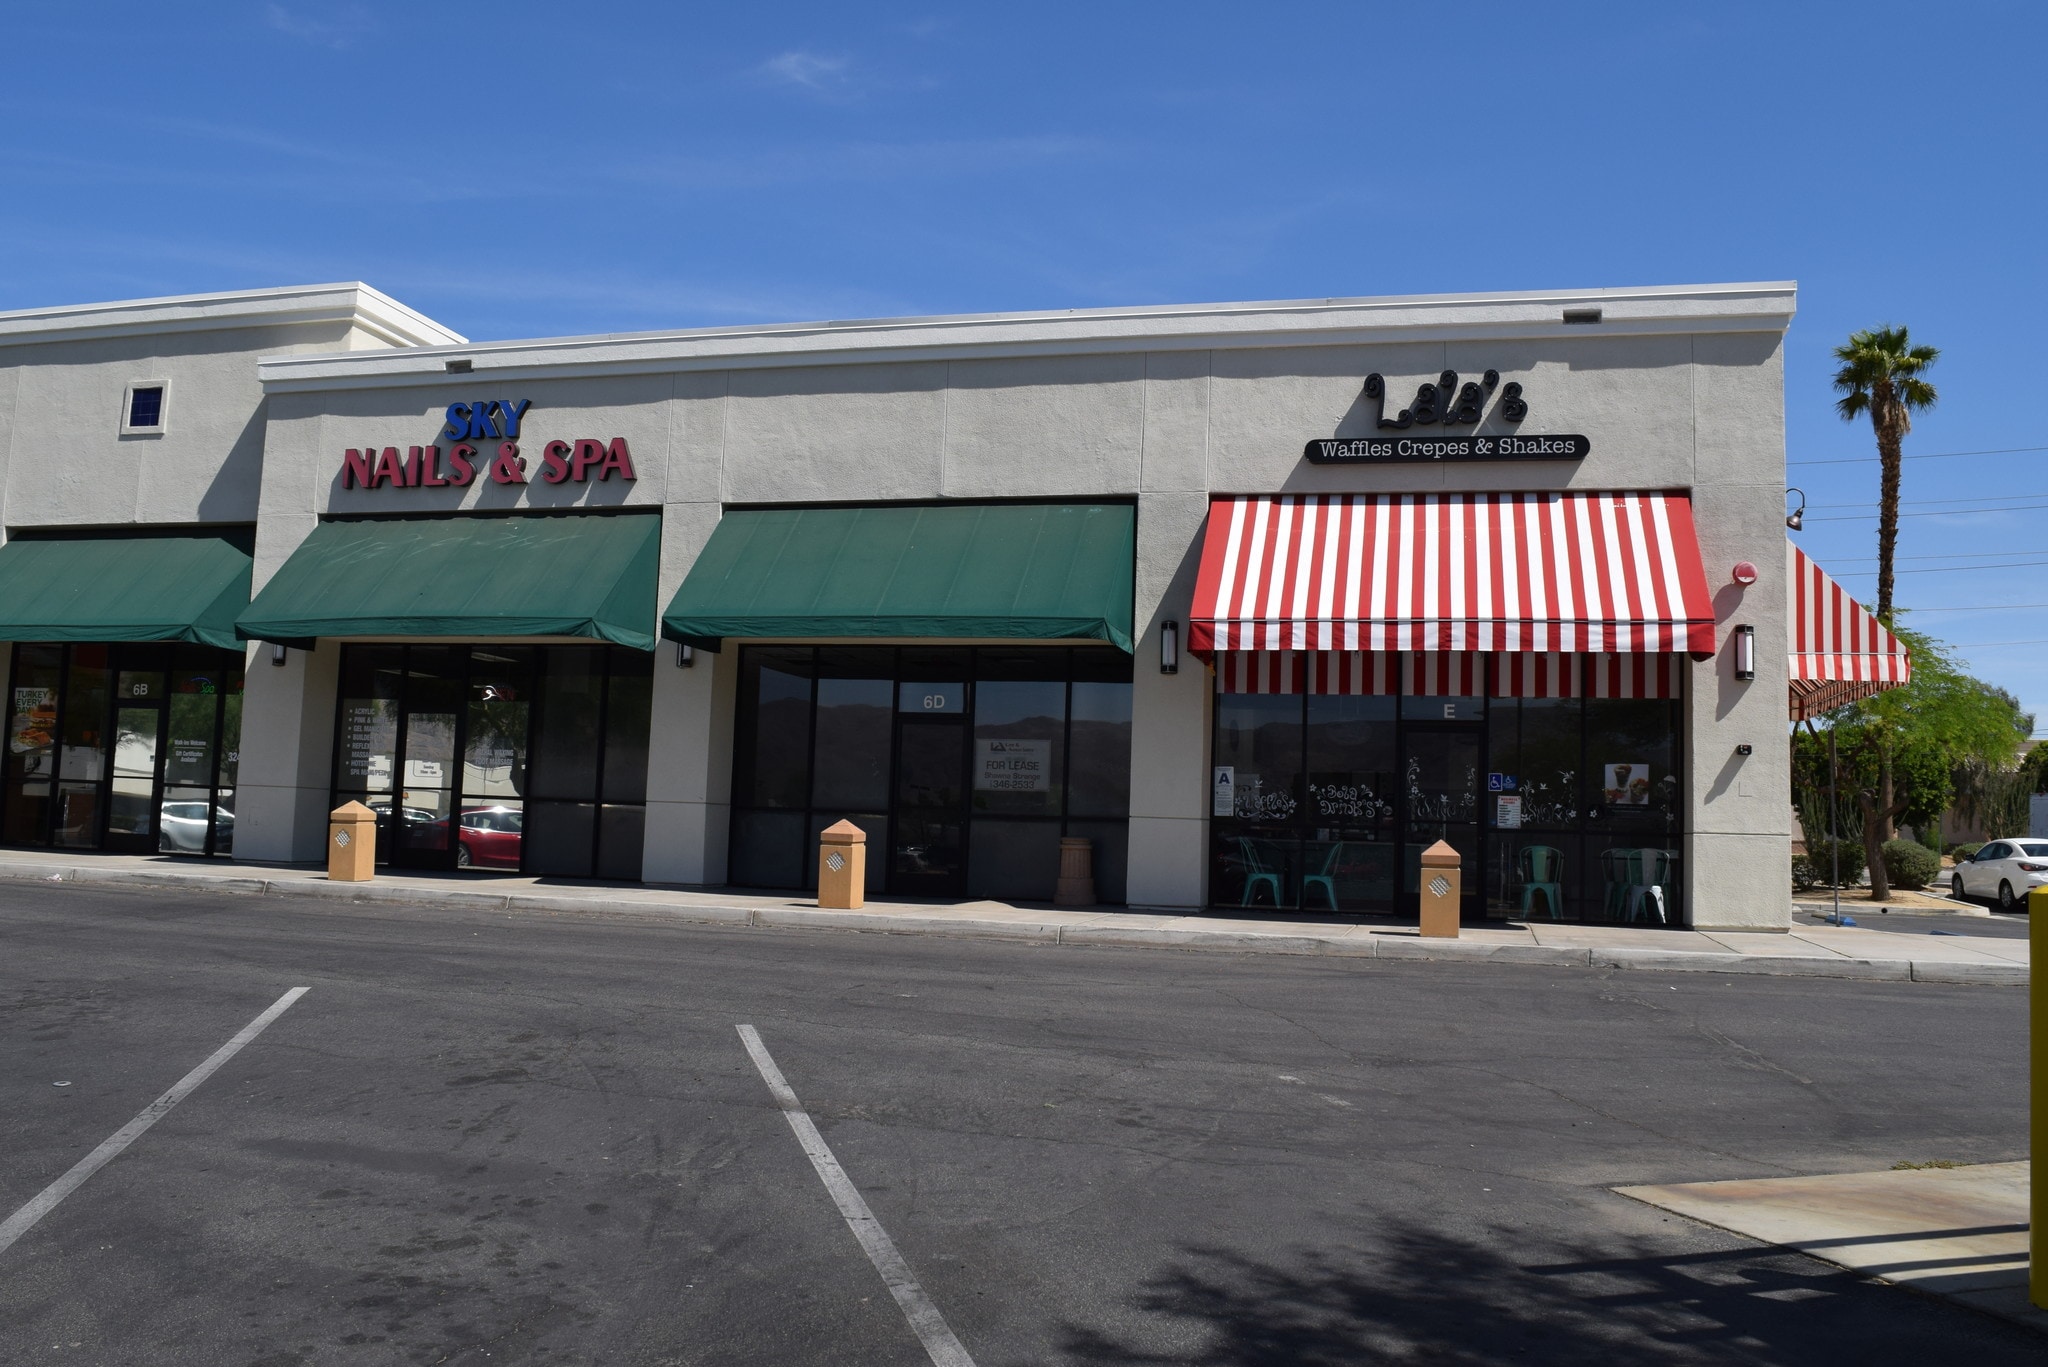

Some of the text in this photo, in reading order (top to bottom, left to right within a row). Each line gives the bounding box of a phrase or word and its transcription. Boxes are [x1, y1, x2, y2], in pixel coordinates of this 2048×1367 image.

[444, 399, 532, 441] SKY
[1319, 437, 1576, 459] Waffles Crepes & Shakes
[342, 437, 637, 489] NAILS & SPA
[16, 690, 48, 699] TURKEY
[133, 683, 148, 696] 6B
[16, 699, 42, 707] EVERY
[923, 695, 945, 709] 6D
[1444, 703, 1455, 719] E
[986, 760, 1039, 771] FOR LEASE
[1218, 772, 1230, 784] A
